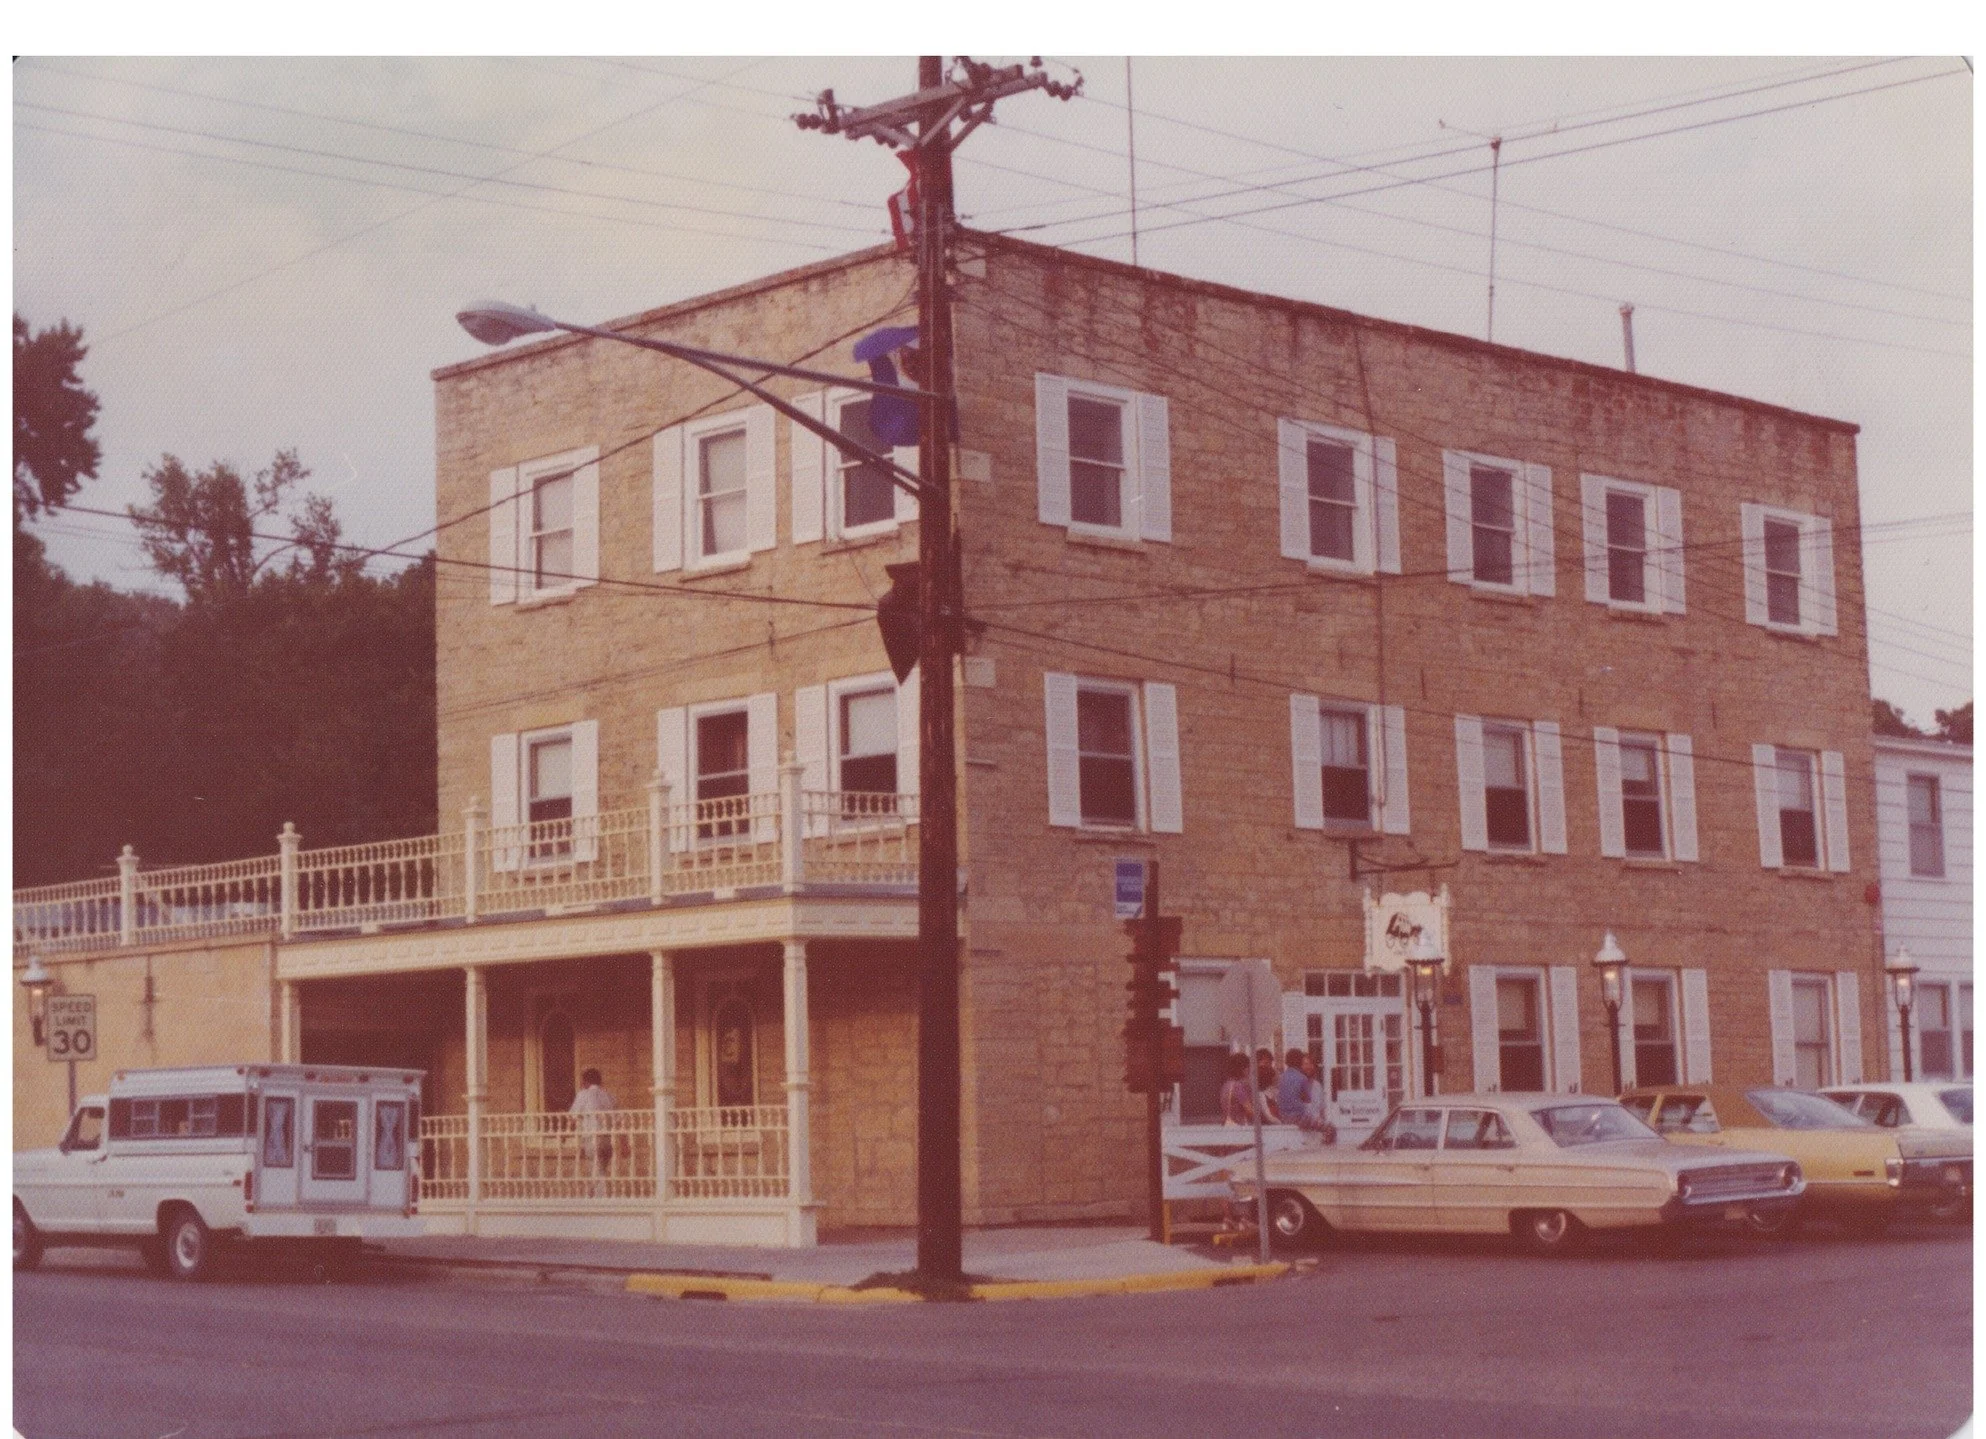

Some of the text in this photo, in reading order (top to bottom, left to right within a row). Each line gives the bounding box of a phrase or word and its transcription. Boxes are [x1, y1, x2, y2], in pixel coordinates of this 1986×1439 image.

[51, 1001, 92, 1013] SPEED
[55, 1015, 87, 1026] LIMIT
[53, 1029, 92, 1054] 30
